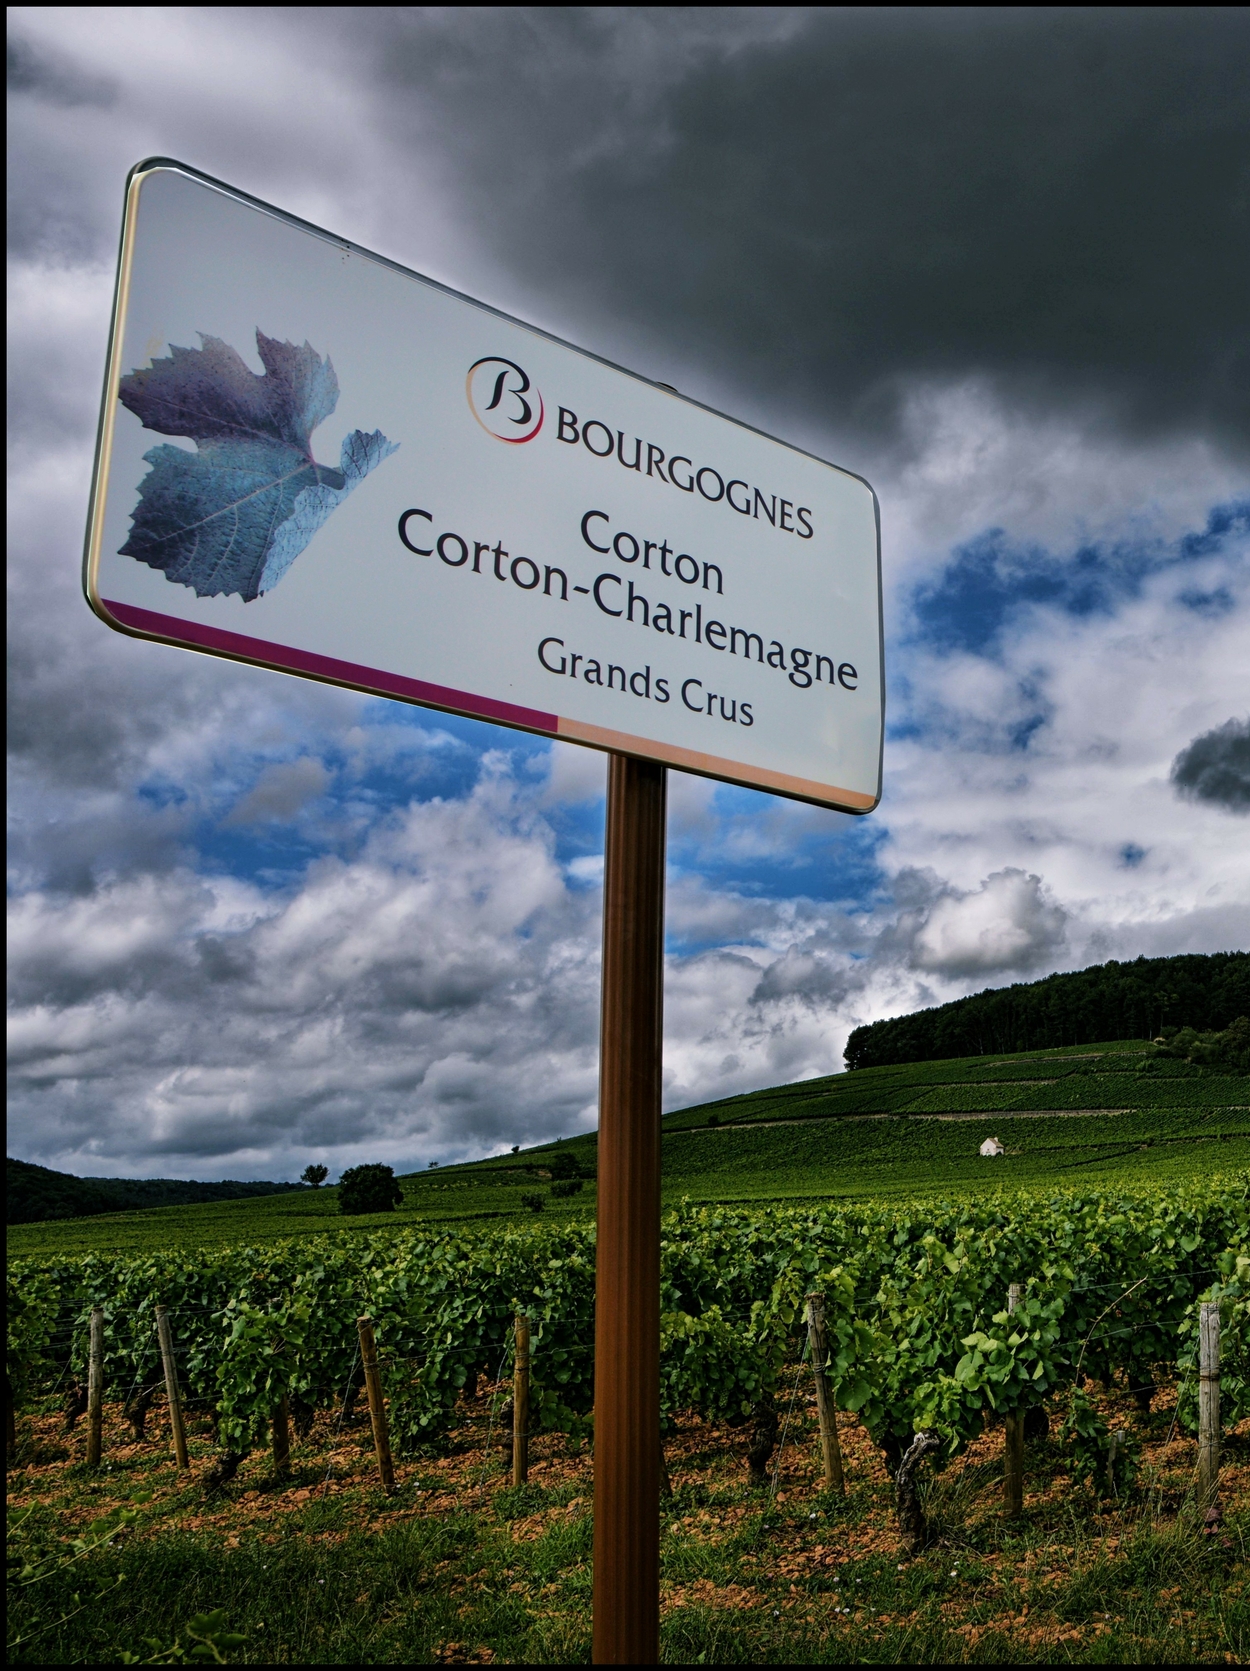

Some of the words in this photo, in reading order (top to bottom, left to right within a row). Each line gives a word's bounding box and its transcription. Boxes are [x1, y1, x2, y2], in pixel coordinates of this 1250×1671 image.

[555, 405, 814, 539] BOURGOGNES
[397, 508, 859, 691] Corton-Charlemagne
[580, 509, 724, 595] Corton
[537, 636, 670, 703] Grands
[680, 678, 754, 727] Crus
